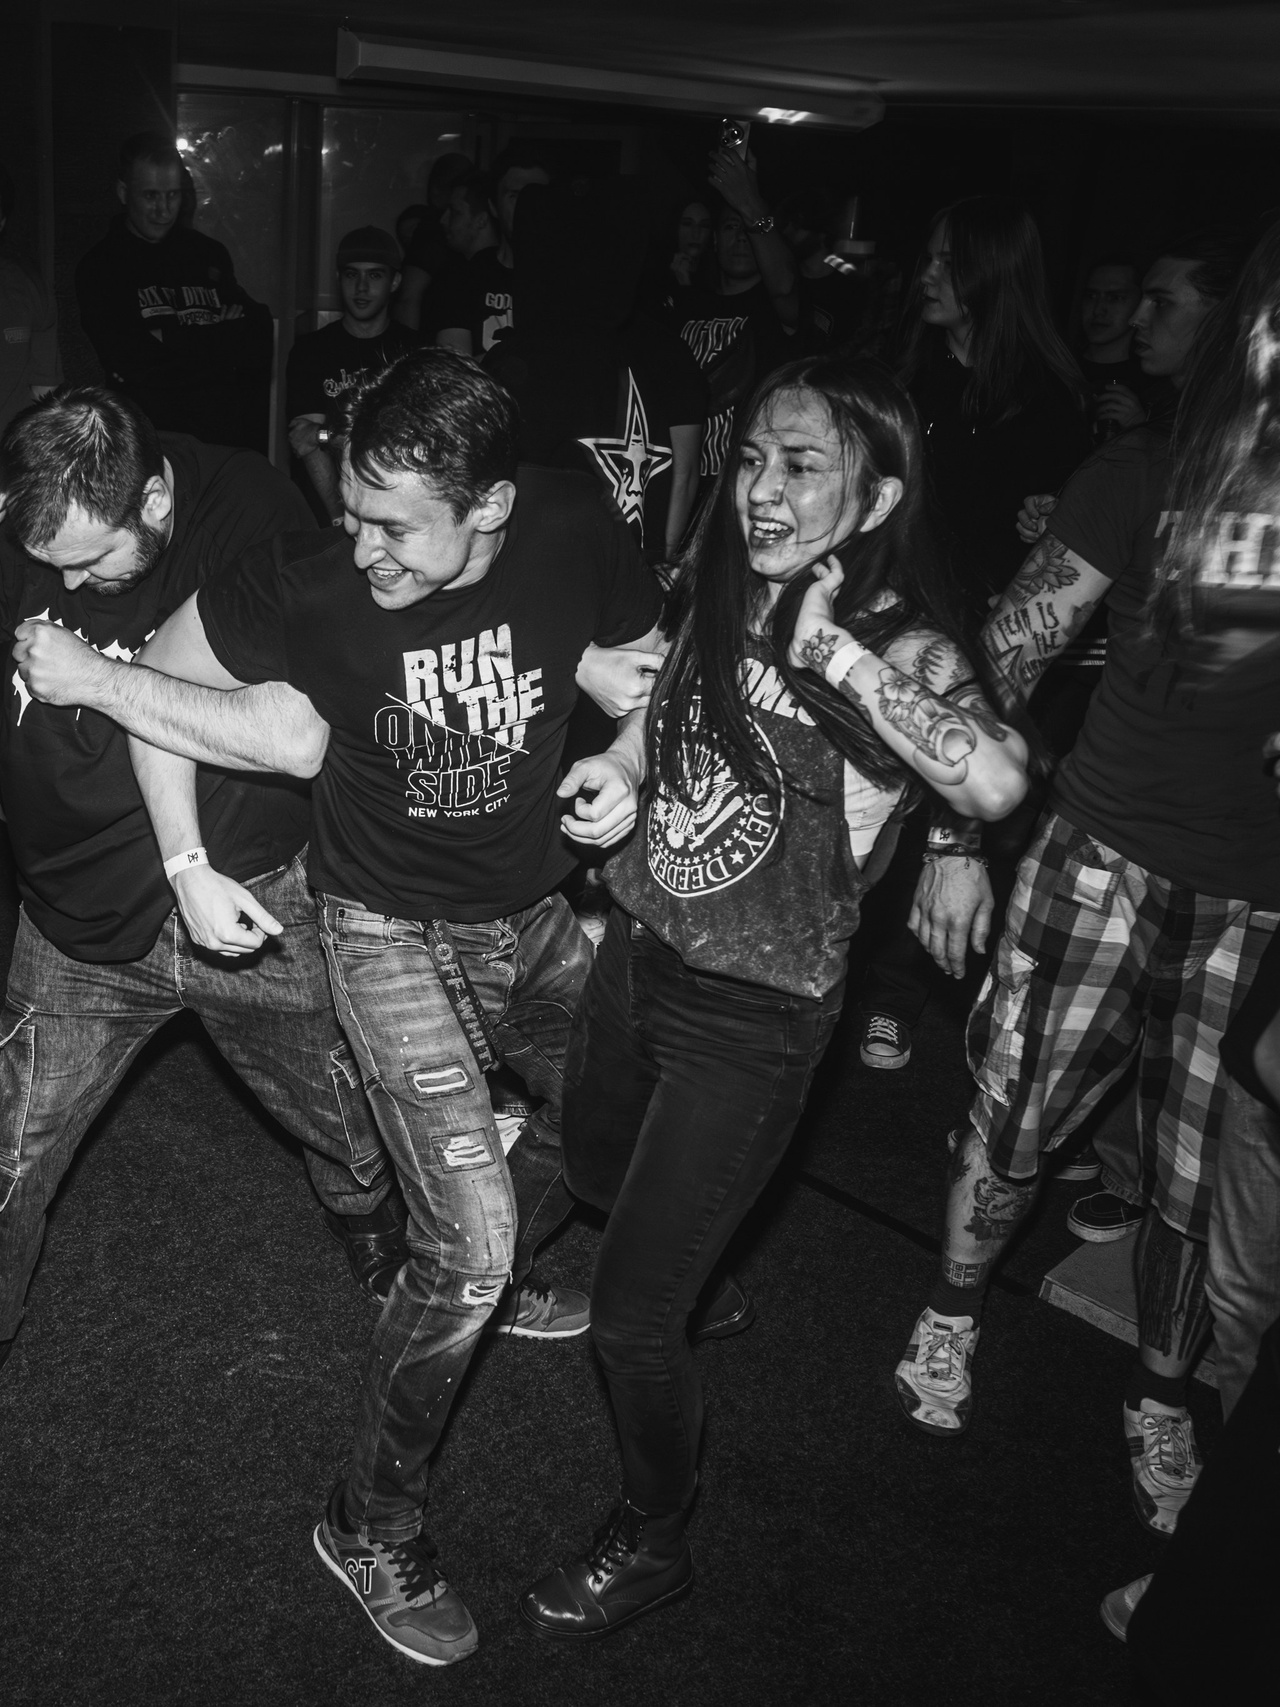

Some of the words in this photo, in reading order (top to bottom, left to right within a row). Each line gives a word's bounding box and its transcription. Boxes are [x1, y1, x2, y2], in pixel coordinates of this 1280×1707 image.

[402, 623, 515, 704] RUN
[374, 696, 448, 751] ON
[457, 668, 545, 734] THE
[406, 756, 511, 809] SIDE
[408, 806, 438, 818] NEW
[443, 808, 480, 818] YORK
[485, 794, 511, 814] CITY
